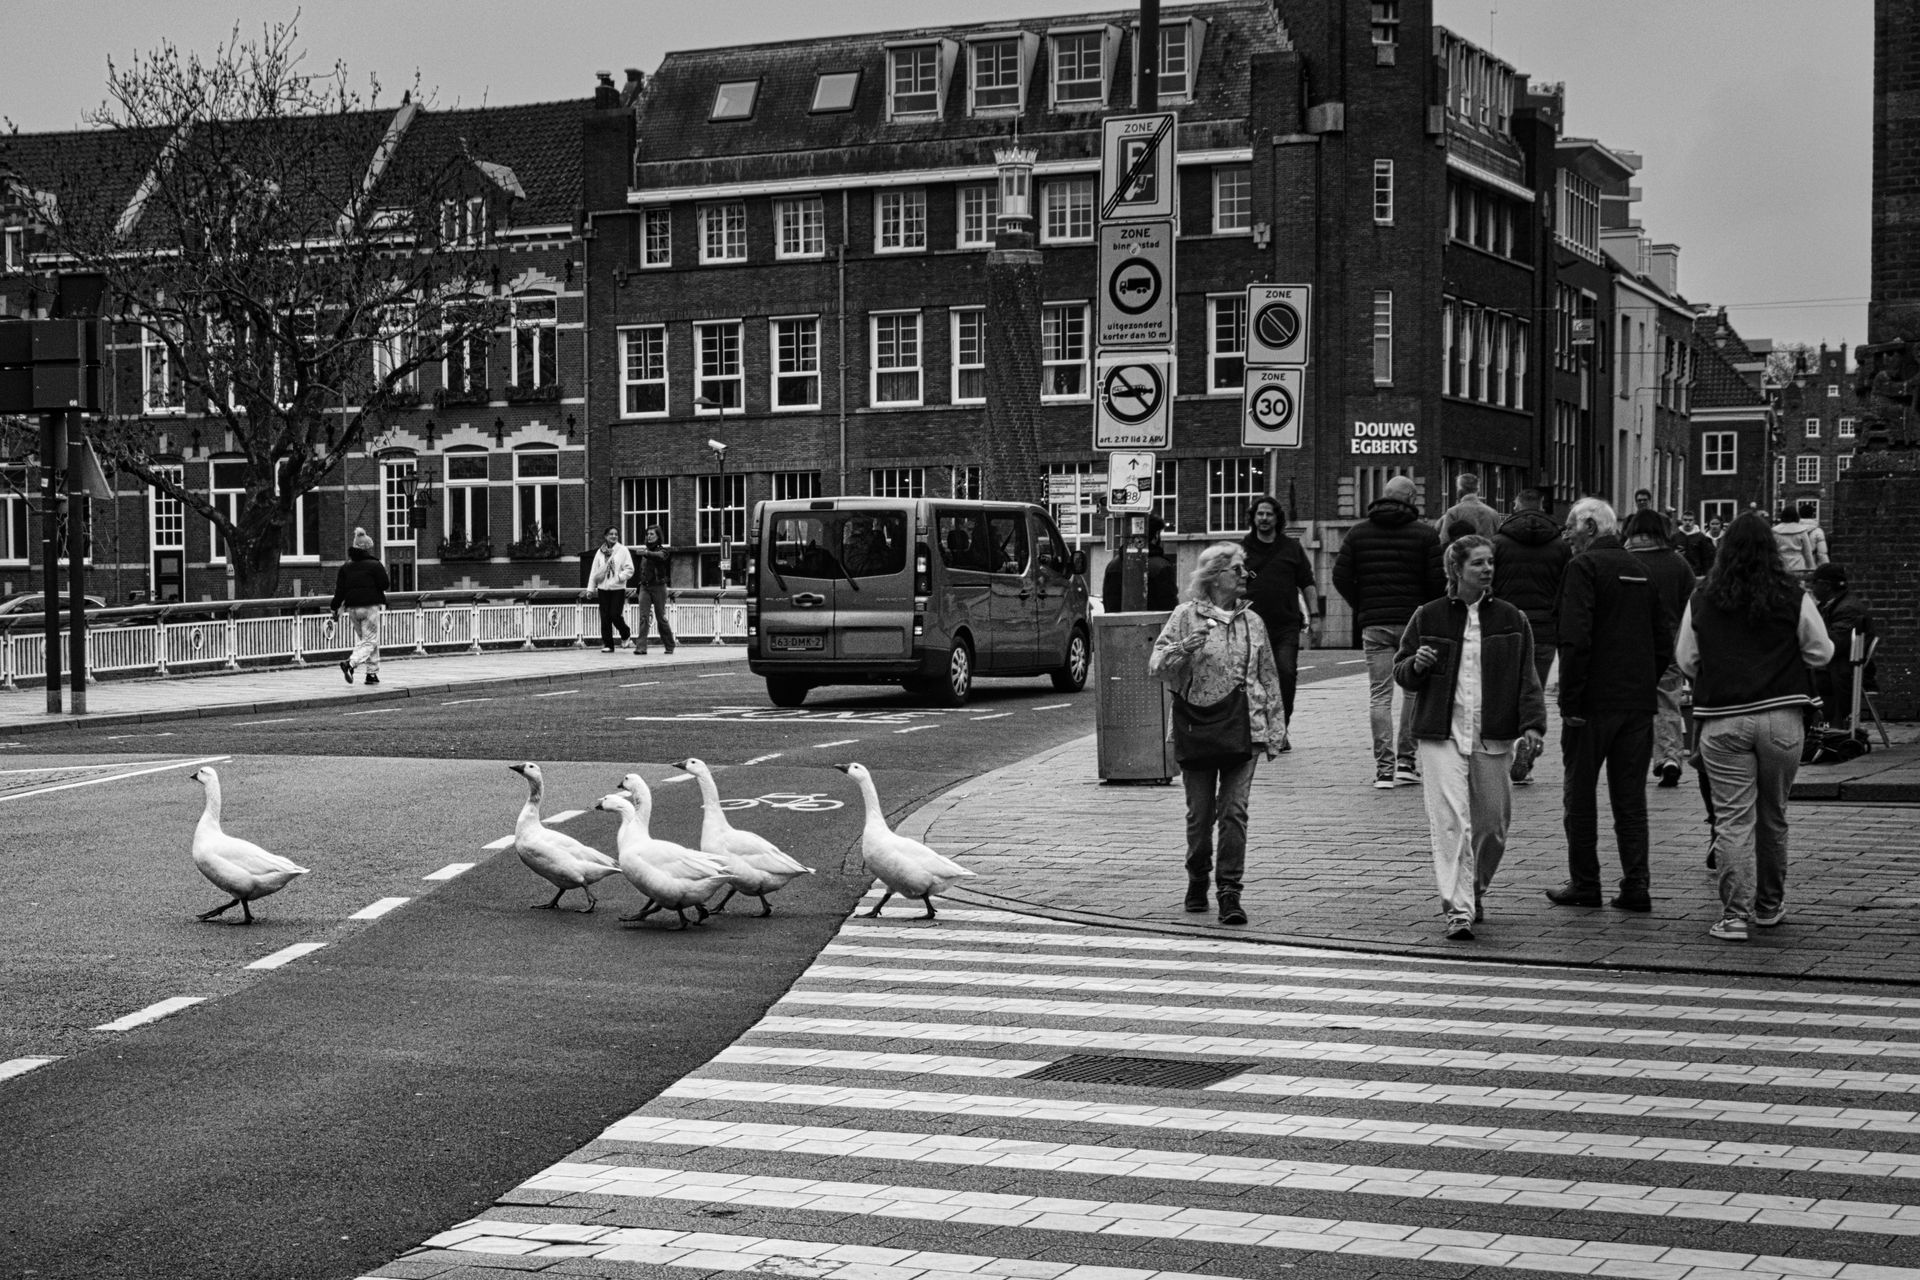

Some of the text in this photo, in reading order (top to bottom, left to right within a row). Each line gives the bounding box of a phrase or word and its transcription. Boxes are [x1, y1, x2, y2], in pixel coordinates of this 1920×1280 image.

[1124, 121, 1153, 133] ZONE
[1120, 228, 1150, 239] ZONE
[1113, 240, 1160, 250] binnstad
[1265, 290, 1292, 299] ZONE
[1107, 321, 1163, 331] uitgezonderd
[1261, 372, 1286, 381] ZONE
[1259, 398, 1287, 417] 30
[1130, 435, 1141, 443] lid
[1142, 435, 1148, 443] 2
[1351, 438, 1418, 454] EGBERTS
[677, 709, 946, 720] ZONE
